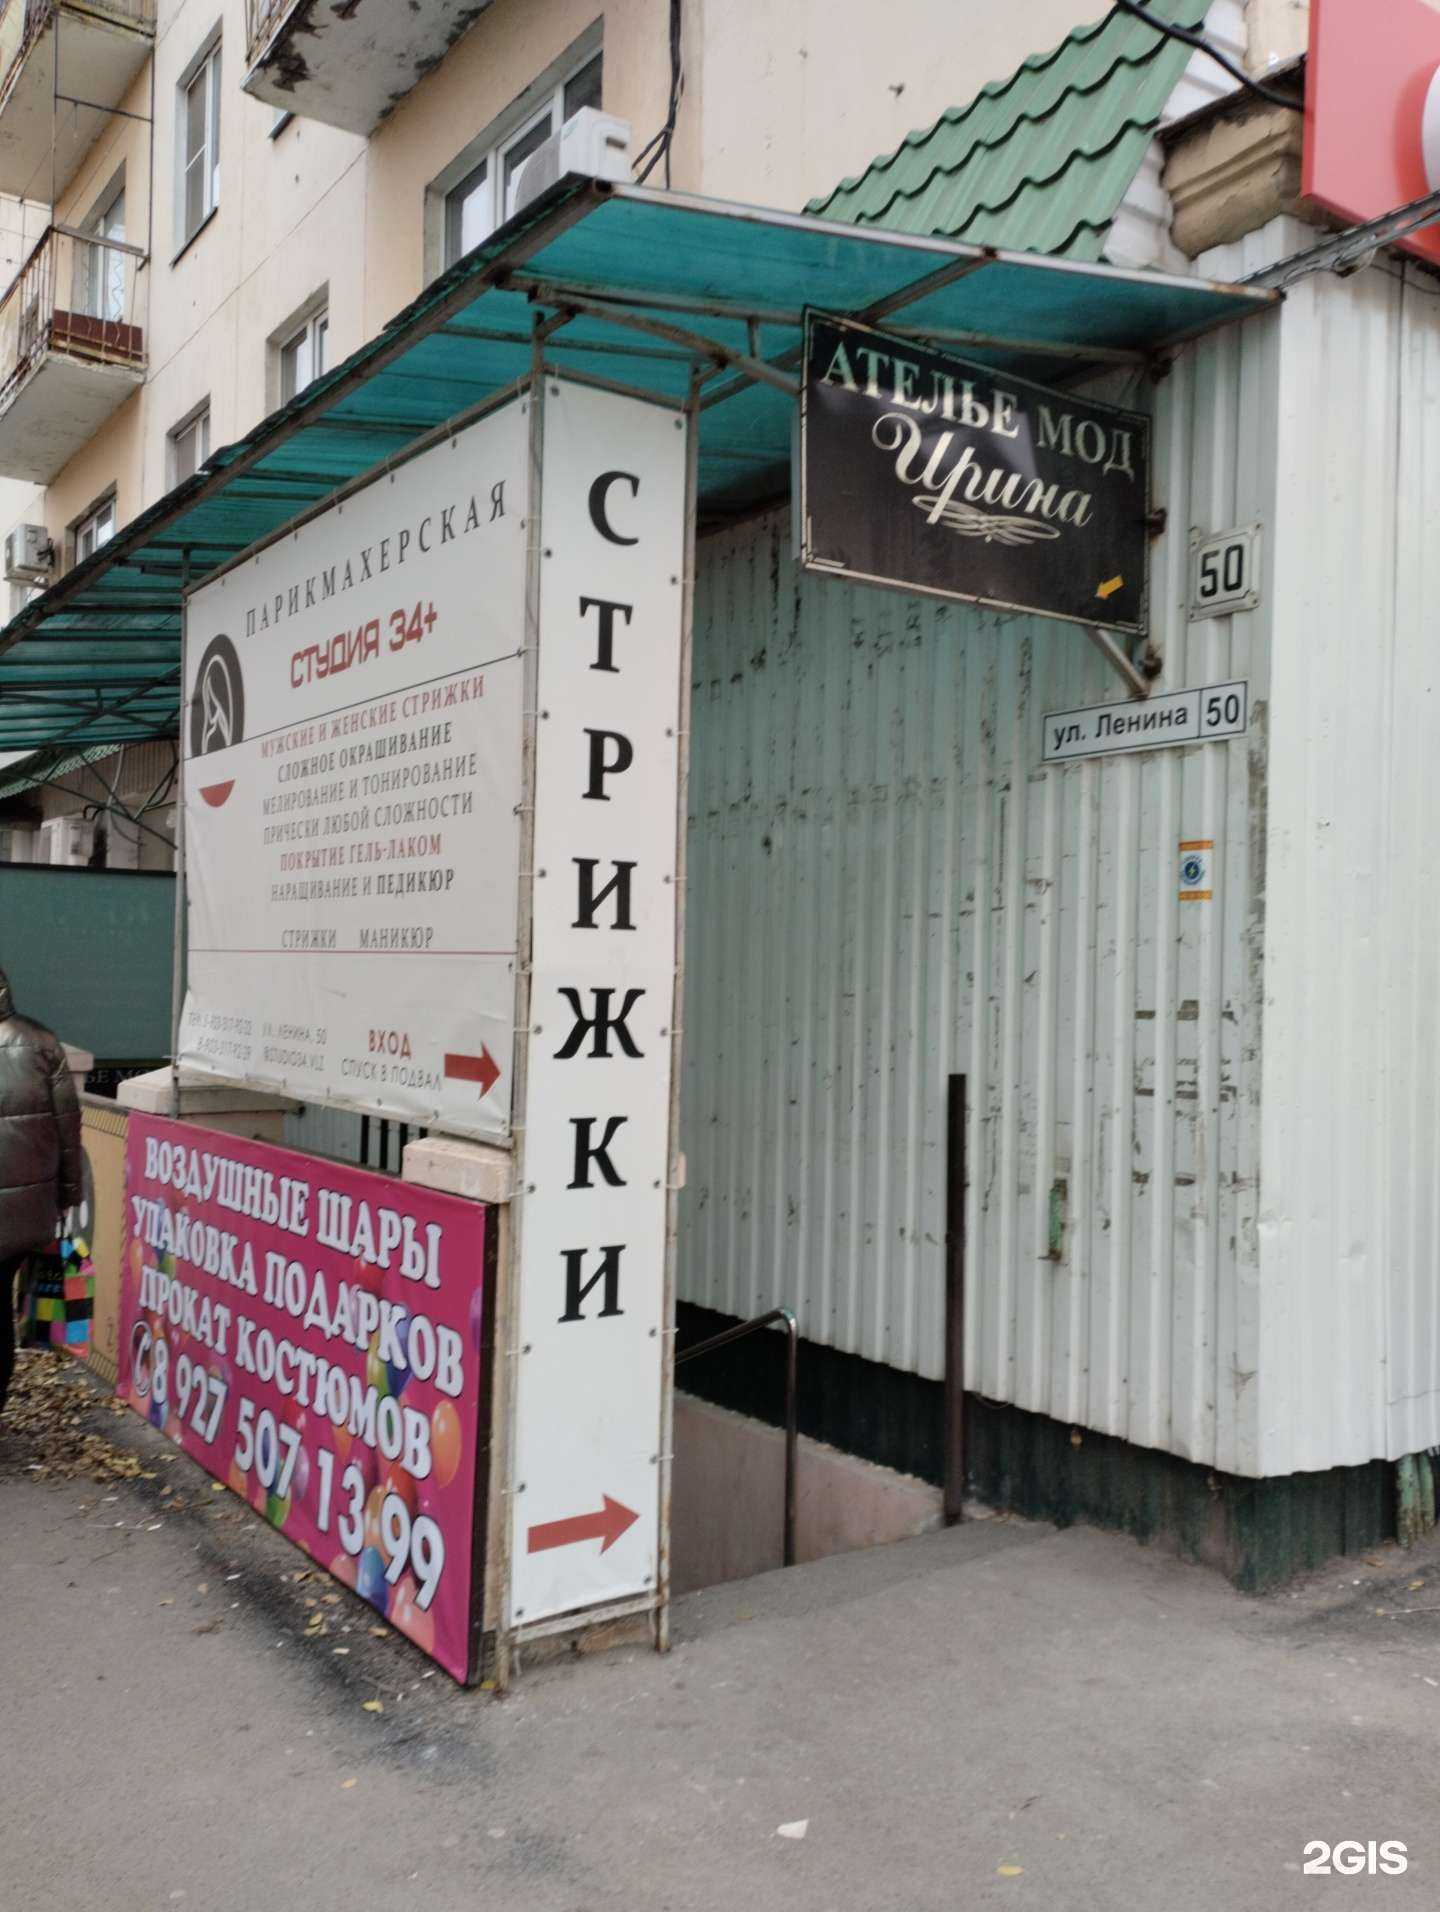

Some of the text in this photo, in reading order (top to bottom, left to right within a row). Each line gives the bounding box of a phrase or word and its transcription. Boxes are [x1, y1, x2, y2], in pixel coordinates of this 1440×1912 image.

[819, 340, 1136, 483] АТЕЛЬЕ МОД
[871, 411, 1094, 528] Ирина
[245, 479, 507, 638] ПАРИКМАХЕРСКАЯ
[1200, 543, 1245, 599] 50
[290, 600, 438, 690] СТУДИЯ 34+
[261, 674, 485, 759] МУЖСКИЕ И ЖЕНСКИЕ СТРИЖКИ
[277, 722, 453, 783] СЛОЖНОЕ ОКРАШИВАНИЕ
[1053, 693, 1240, 751] ул. Ленина 50
[262, 752, 478, 816] МЕЛИРОВАНИЕ И ТОНИРОВАНИЕ
[263, 791, 474, 845] ПРИЧЕСКИ ЛЮБОЙ СЛОЖНОСТИ
[271, 868, 455, 903] НАРАЩИВАНИЕ И ПЕДИКЮР
[280, 833, 442, 872] ПОКРЫТИЕ ГЕЛЬ-ЛАКОМ
[552, 469, 647, 1324] СТРИЖКИ
[281, 926, 434, 949] СТРИЖКИ МАНИКЮР
[341, 1057, 377, 1081] СПУСК
[390, 1065, 442, 1092] ПОДВАЛ
[368, 1029, 412, 1060] ВХОД
[144, 1135, 443, 1290] ВОЗДУШНЫЕ ШАРЫ
[131, 1195, 465, 1399] УПАКОВКА ПОДАРКОВ
[139, 1264, 433, 1481] ПРОКАТ КОСТЮМОВ
[152, 1338, 445, 1612] 8 927 507 13 99
